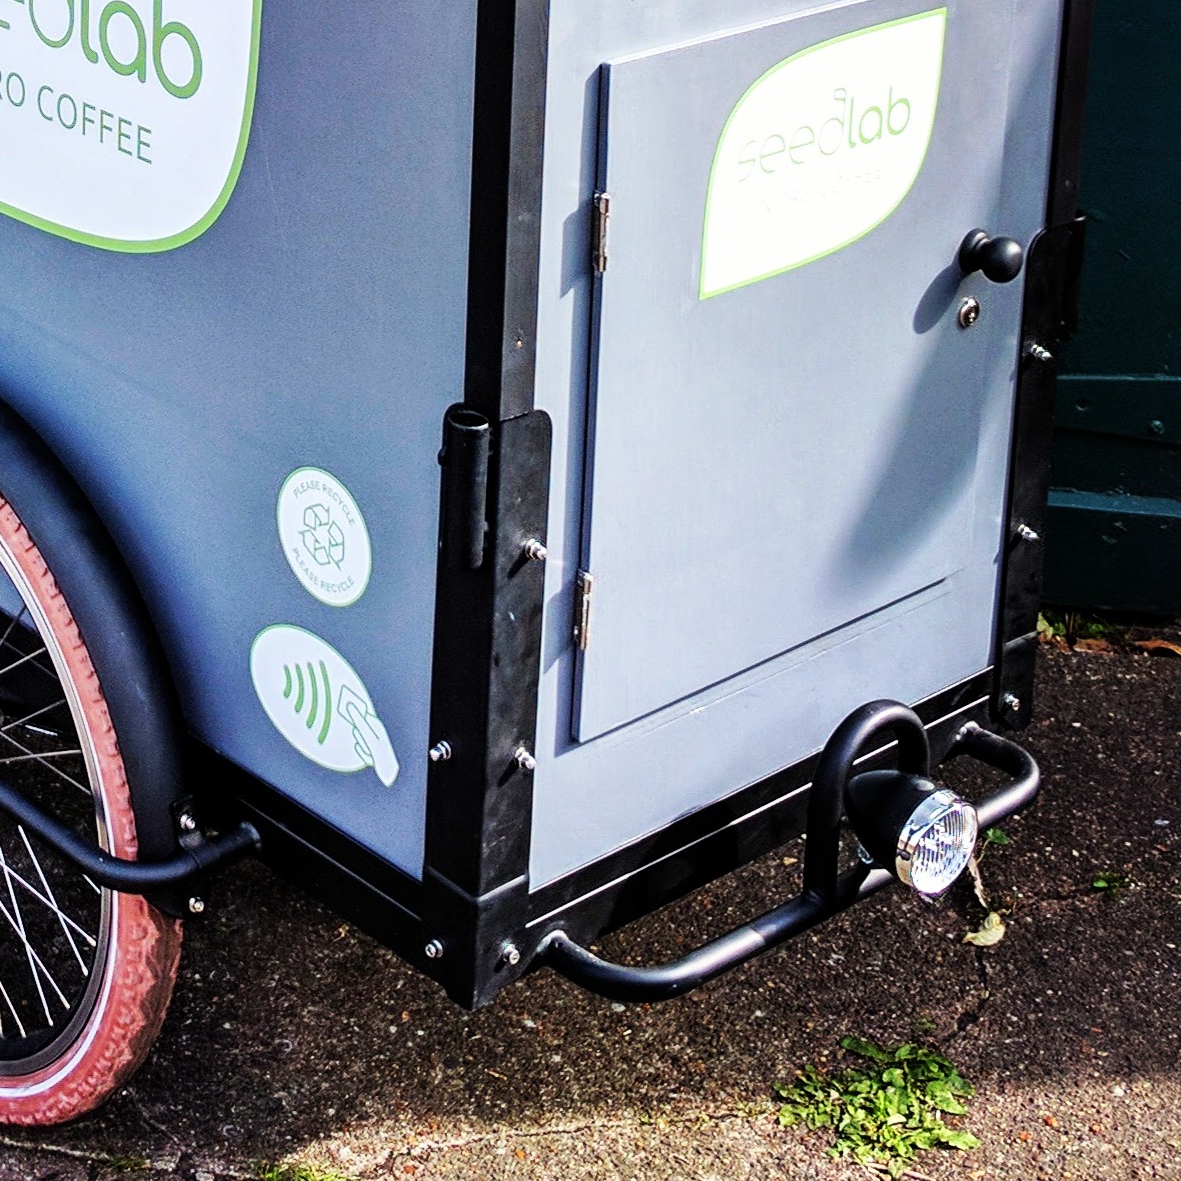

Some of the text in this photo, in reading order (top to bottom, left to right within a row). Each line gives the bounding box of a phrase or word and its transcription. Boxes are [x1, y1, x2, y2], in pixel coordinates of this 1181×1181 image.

[37, 85, 153, 165] COFFEE
[737, 85, 911, 184] seedlab
[293, 480, 356, 527] PLEASE RECYCLE
[292, 547, 355, 593] PLEASE RECYCLE
